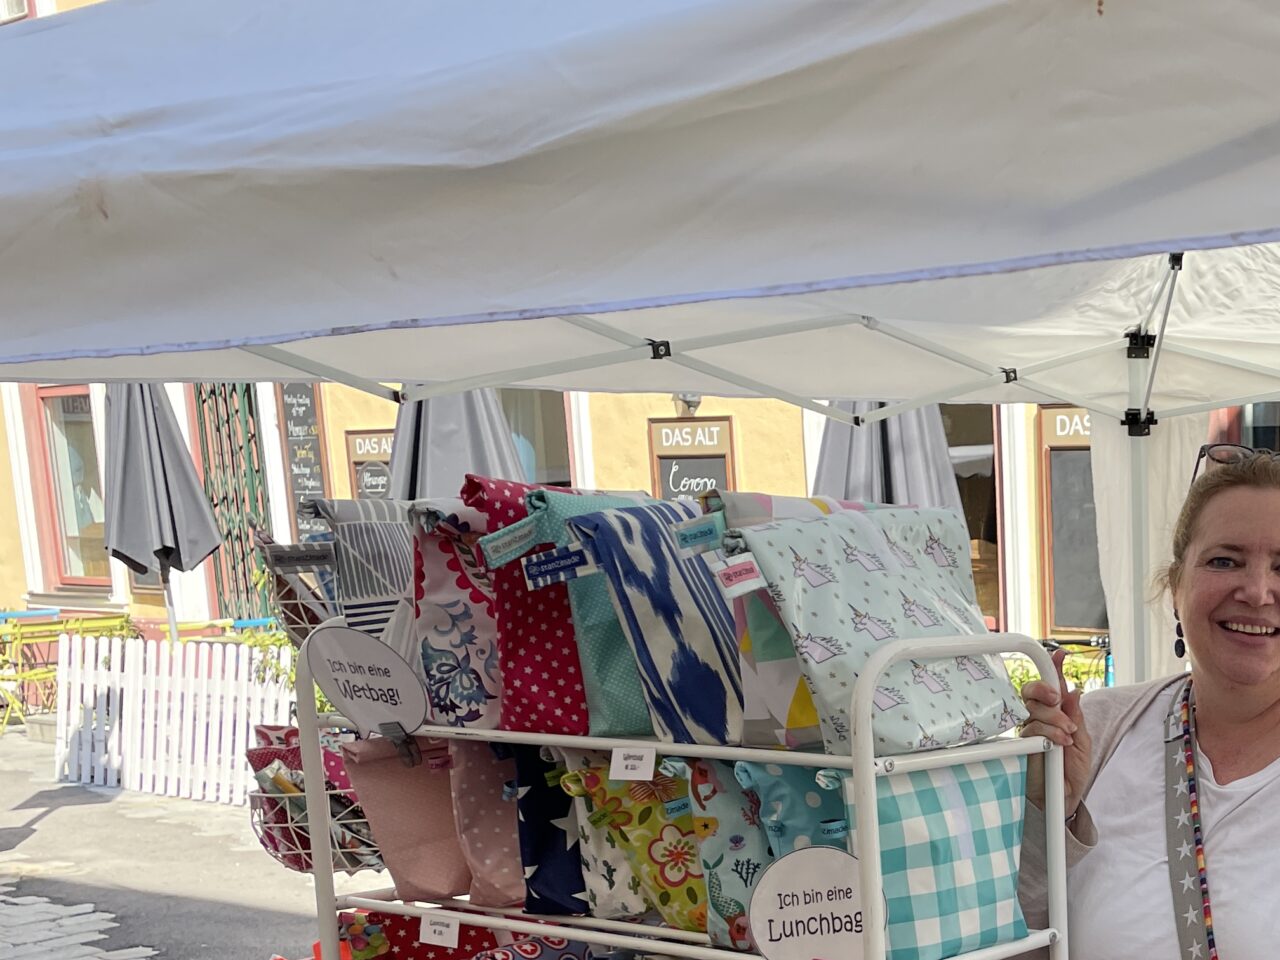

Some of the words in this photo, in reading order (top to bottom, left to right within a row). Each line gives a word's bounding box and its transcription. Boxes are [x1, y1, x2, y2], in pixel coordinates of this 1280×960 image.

[355, 438, 379, 454] DAS
[661, 427, 692, 447] DAS
[694, 426, 720, 446] ALT
[326, 658, 348, 673] Ich
[347, 661, 367, 675] bin
[367, 664, 392, 678] eine
[333, 677, 403, 706] Wetbag!
[777, 891, 800, 910] Ich
[803, 888, 823, 906] bin
[826, 886, 853, 902] eine
